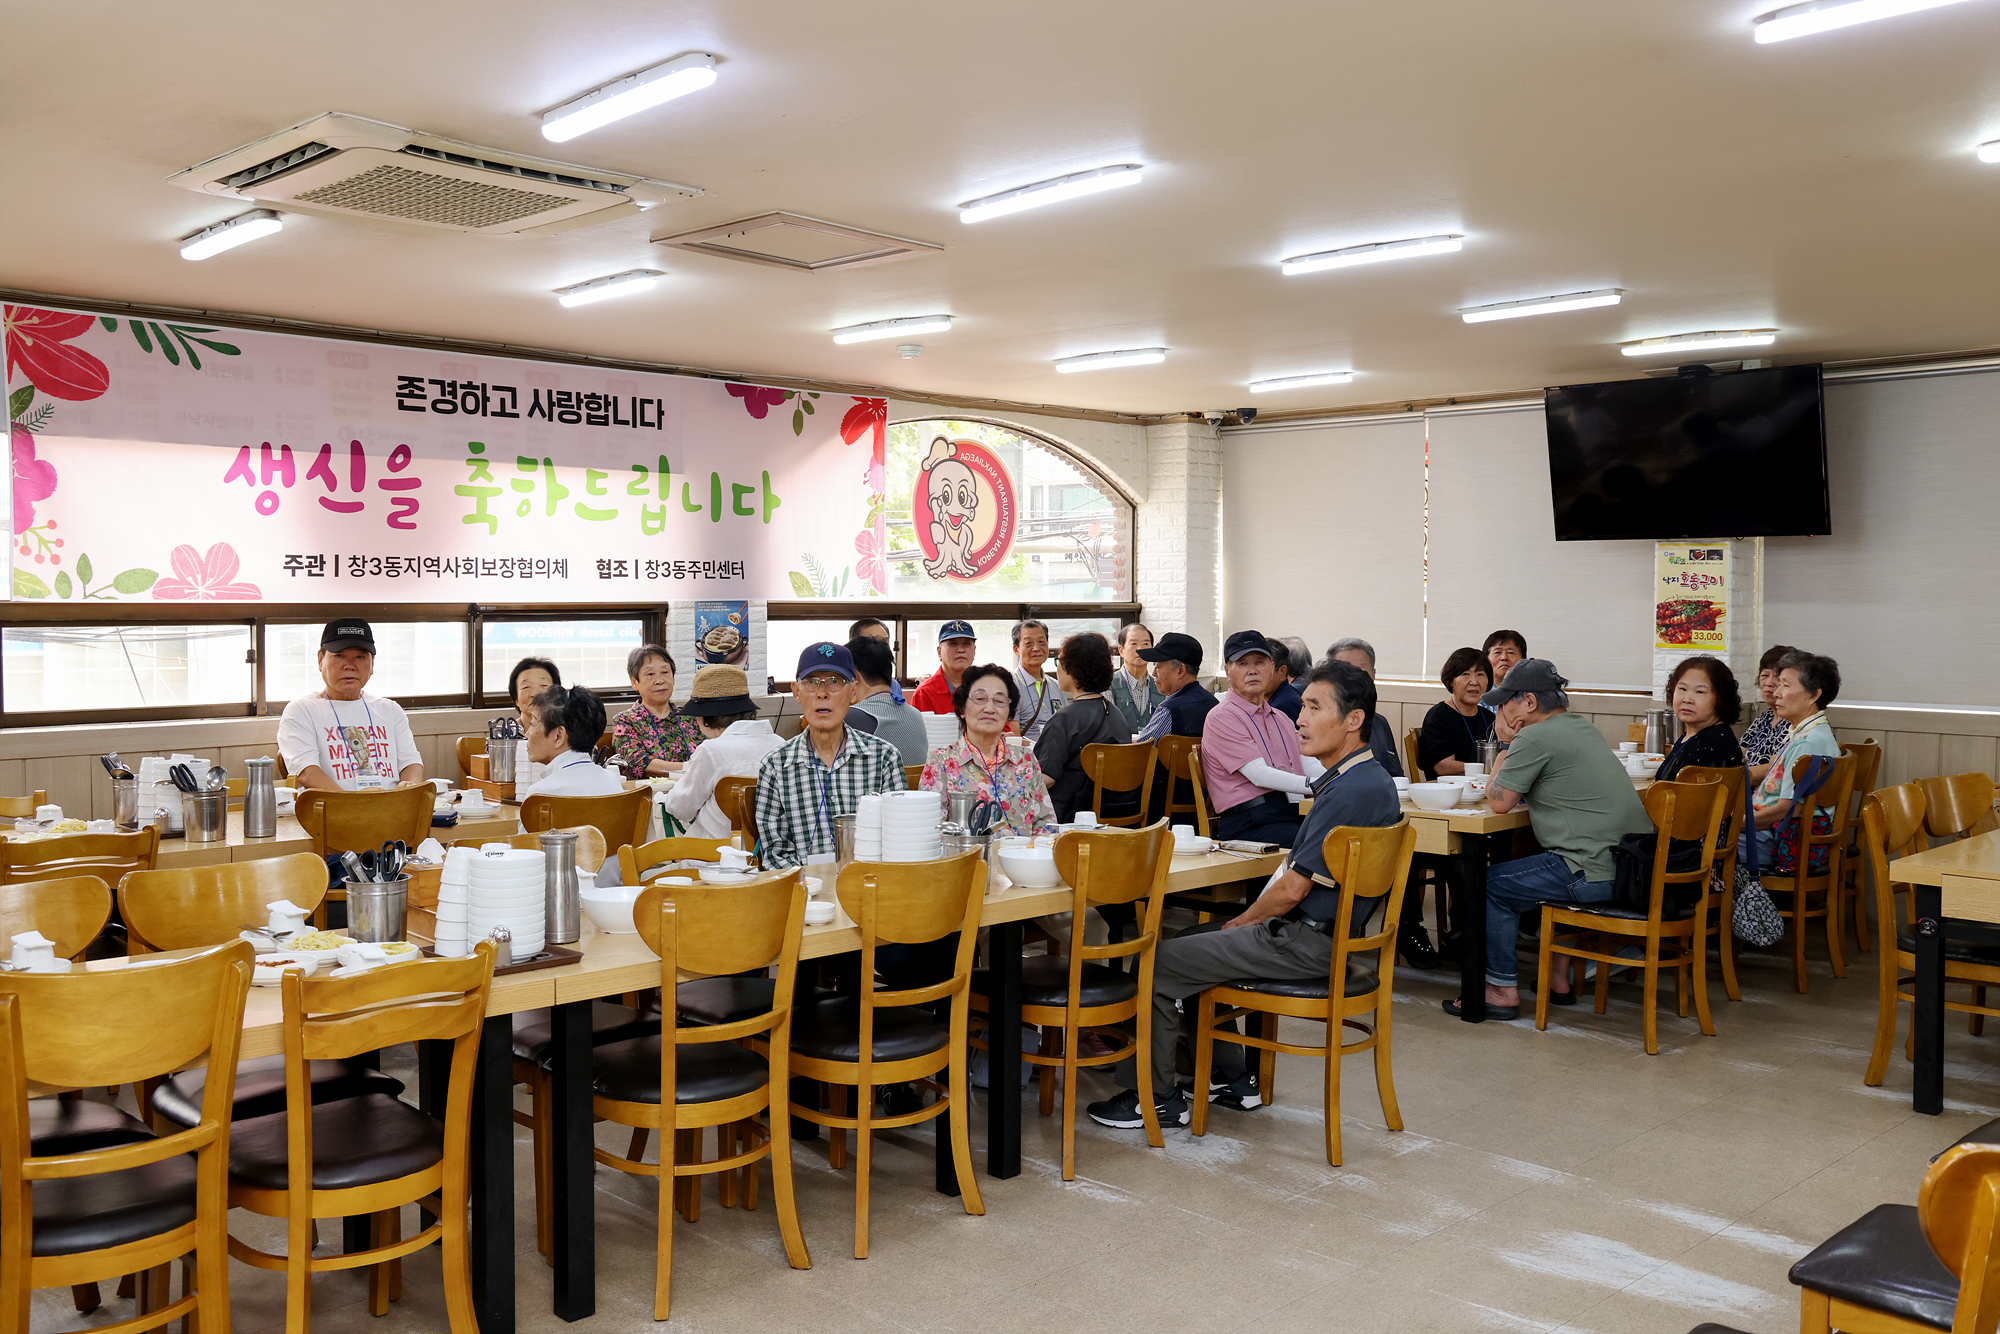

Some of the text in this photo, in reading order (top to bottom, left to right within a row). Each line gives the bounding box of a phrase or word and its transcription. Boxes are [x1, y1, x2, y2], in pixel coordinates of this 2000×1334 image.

[396, 376, 664, 430] 존경하고 사랑합니다
[224, 440, 781, 536] 생신을 축하드립니다
[284, 554, 326, 577] 주관
[348, 555, 568, 578] 창3동지역사회보장협의체
[597, 559, 629, 579] 협조
[645, 560, 745, 579] 창3동주민센터
[1663, 571, 1724, 591] 낙지 호롱구이
[515, 627, 574, 638] WOOSHIN
[579, 627, 614, 637] dental
[1694, 632, 1722, 641] 33,000
